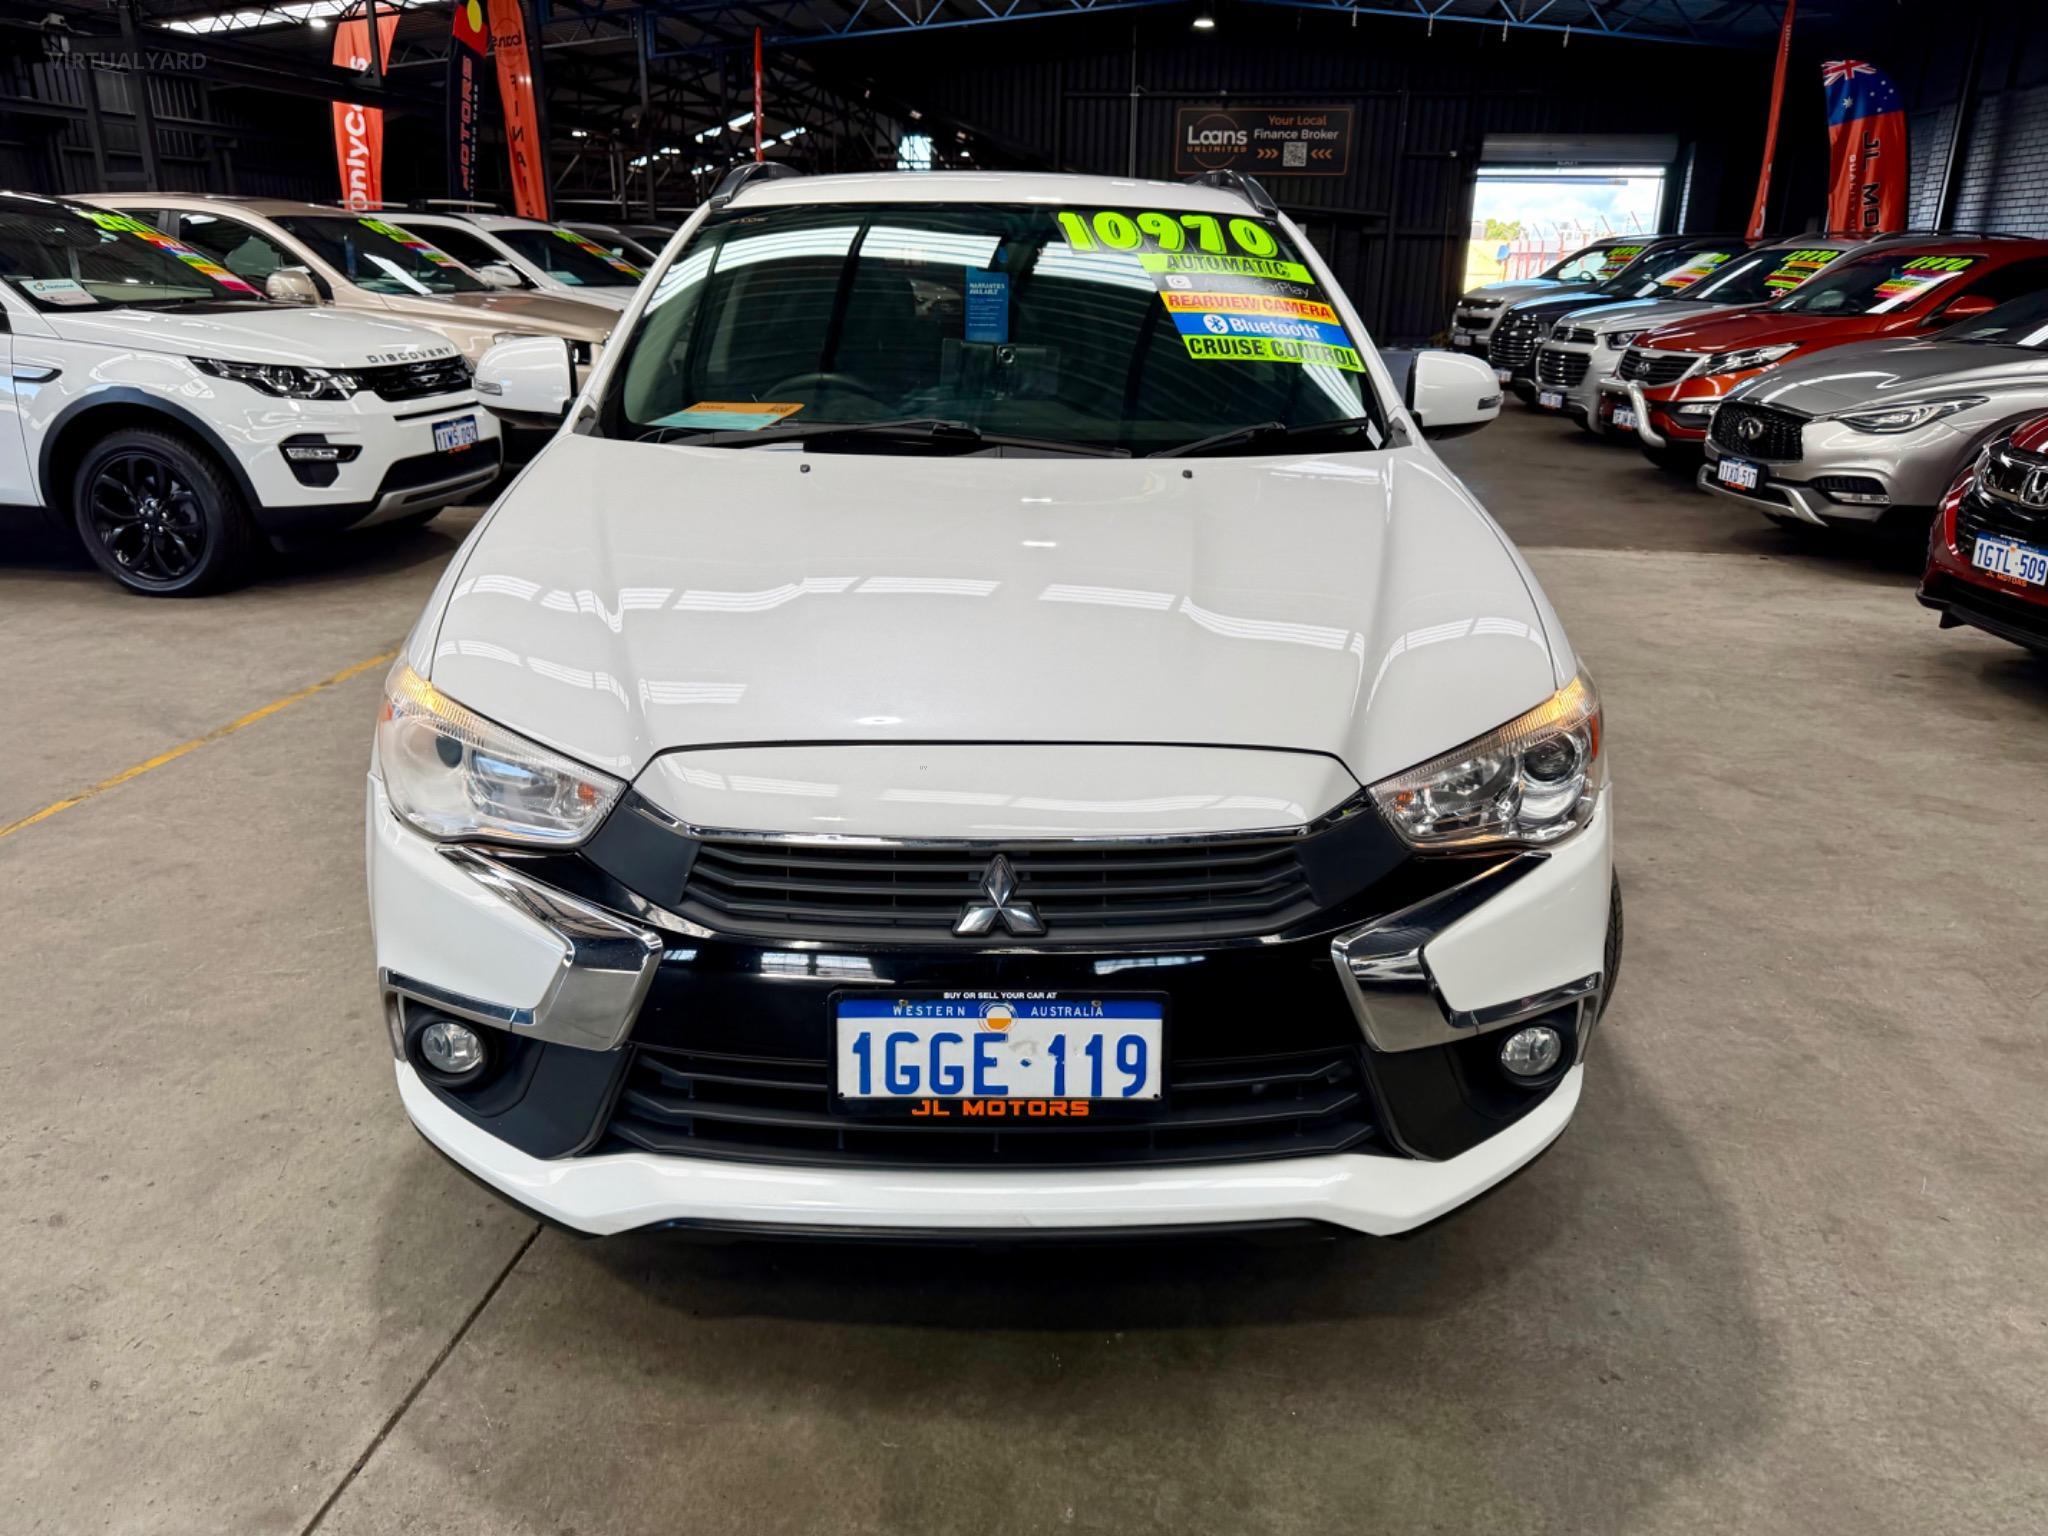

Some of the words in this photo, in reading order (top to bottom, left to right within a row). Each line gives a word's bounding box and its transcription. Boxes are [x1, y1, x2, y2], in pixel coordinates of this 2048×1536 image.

[1268, 115, 1294, 126] Your
[1297, 115, 1327, 126] Local
[1187, 125, 1248, 145] Loans
[1254, 129, 1298, 140] Finance
[1301, 129, 1339, 140] Broker
[1862, 182, 1881, 233] MO
[1058, 212, 1279, 258] 10970
[1166, 255, 1286, 277] AUTOMATIC
[1168, 294, 1259, 311] REARVIEW
[1262, 299, 1330, 318] CAMERA
[1228, 317, 1317, 339] Bluetooth
[366, 346, 451, 364] DISCOVERY
[1188, 337, 1265, 356] CRUISE
[1271, 341, 1359, 367] CONTROL
[1977, 543, 2011, 573] 1GTL
[2019, 554, 2047, 582] 509
[893, 1005, 966, 1017] WESTERN
[1030, 1005, 1104, 1017] AUSTRALIA
[911, 1100, 950, 1117] JL
[962, 1100, 1090, 1117] MOTORS
